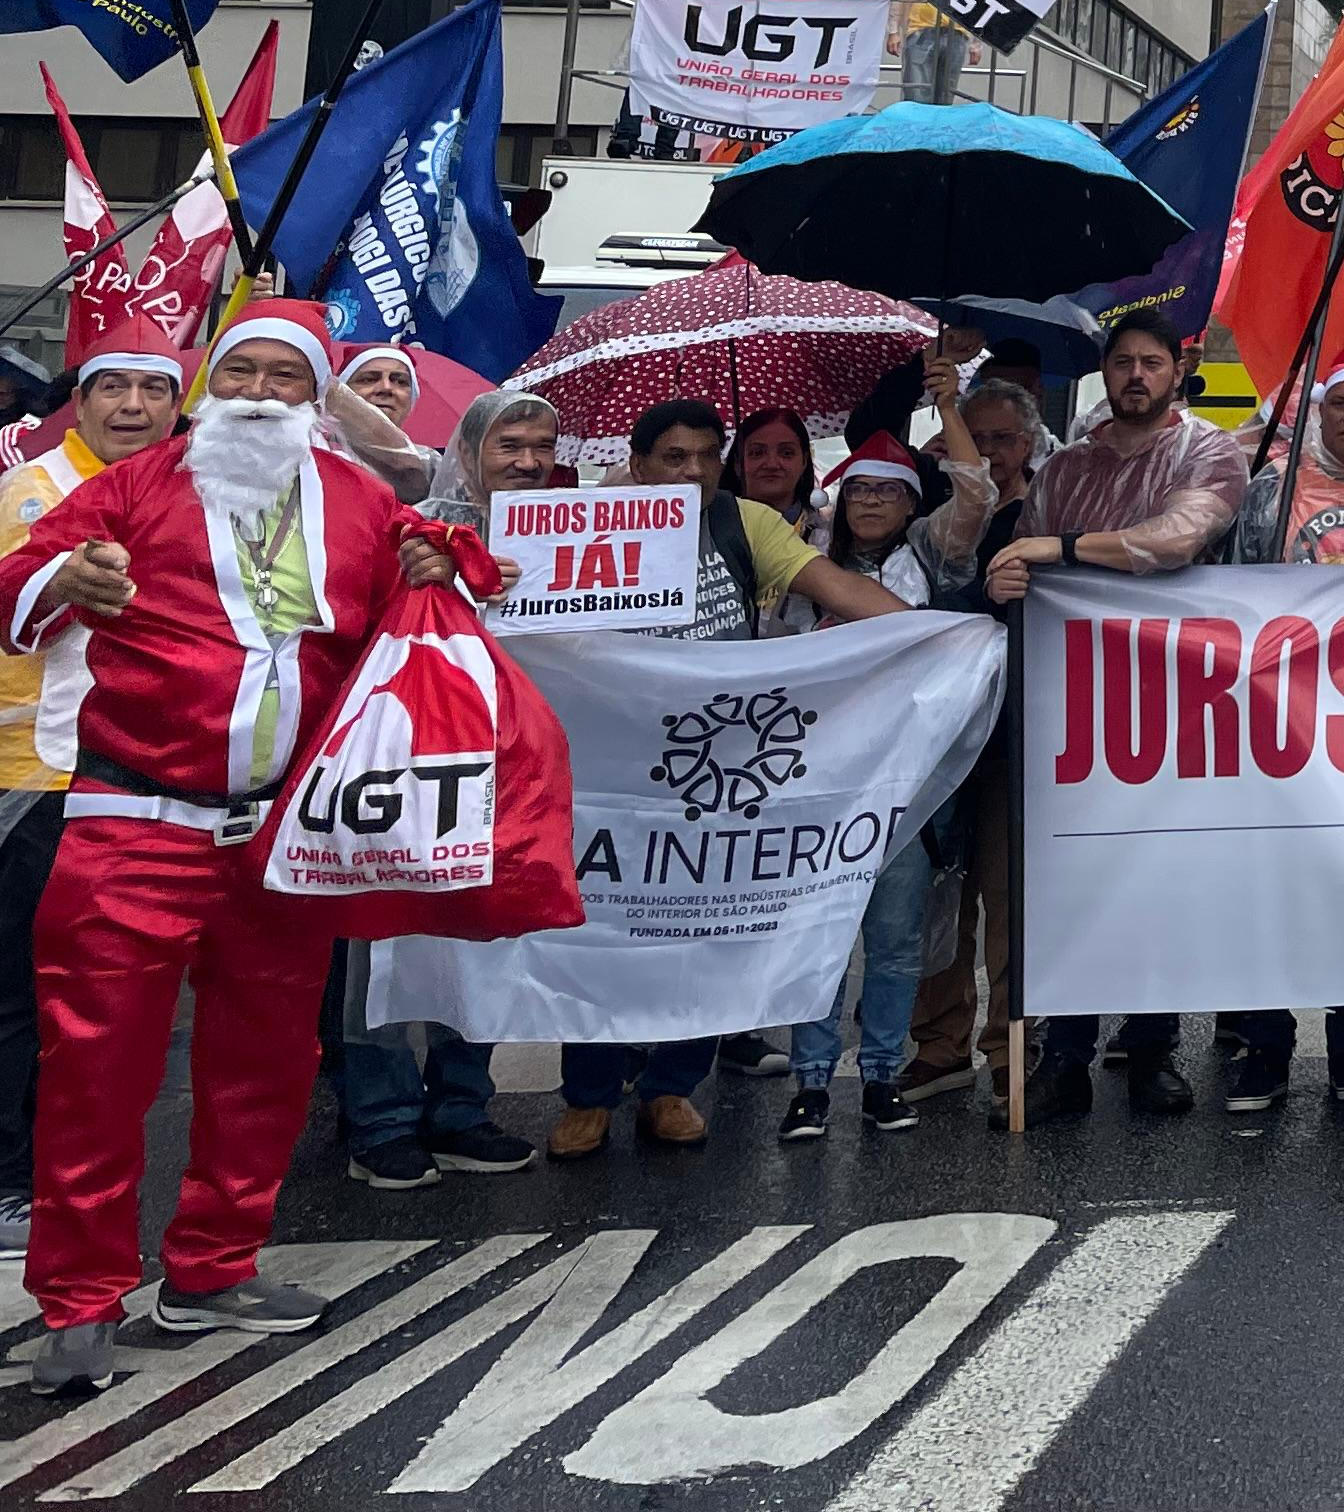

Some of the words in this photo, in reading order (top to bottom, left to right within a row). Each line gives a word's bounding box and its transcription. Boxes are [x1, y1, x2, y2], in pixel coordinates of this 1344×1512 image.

[683, 4, 858, 70] UGT
[676, 57, 733, 77] UNIÃO
[741, 70, 798, 85] GERAL
[809, 74, 851, 86] DOS
[677, 74, 843, 102] TRABALHADORES
[658, 111, 690, 130] UGT
[693, 119, 726, 136] UGT
[728, 126, 762, 141] UGT
[504, 502, 587, 537] JUROS
[593, 498, 685, 532] BAIXOS
[548, 535, 642, 592] JÁ!
[501, 588, 683, 617] #JurosBaixosJá
[298, 762, 493, 840] UGT
[286, 845, 341, 866] UNIÃO
[352, 847, 419, 867] GERAL
[432, 842, 490, 860] DOS
[608, 894, 708, 906] TRABALHADORES
[712, 893, 736, 905] NAS
[739, 885, 803, 903] INDÚSTRIAS
[805, 884, 816, 894] DE
[626, 908, 646, 919] DO
[648, 908, 700, 919] INTERIOR
[704, 908, 721, 918] DE
[723, 904, 748, 917] SÃO
[750, 902, 788, 915] PAULO
[630, 927, 691, 938] FUNDADA
[693, 927, 712, 937] EM
